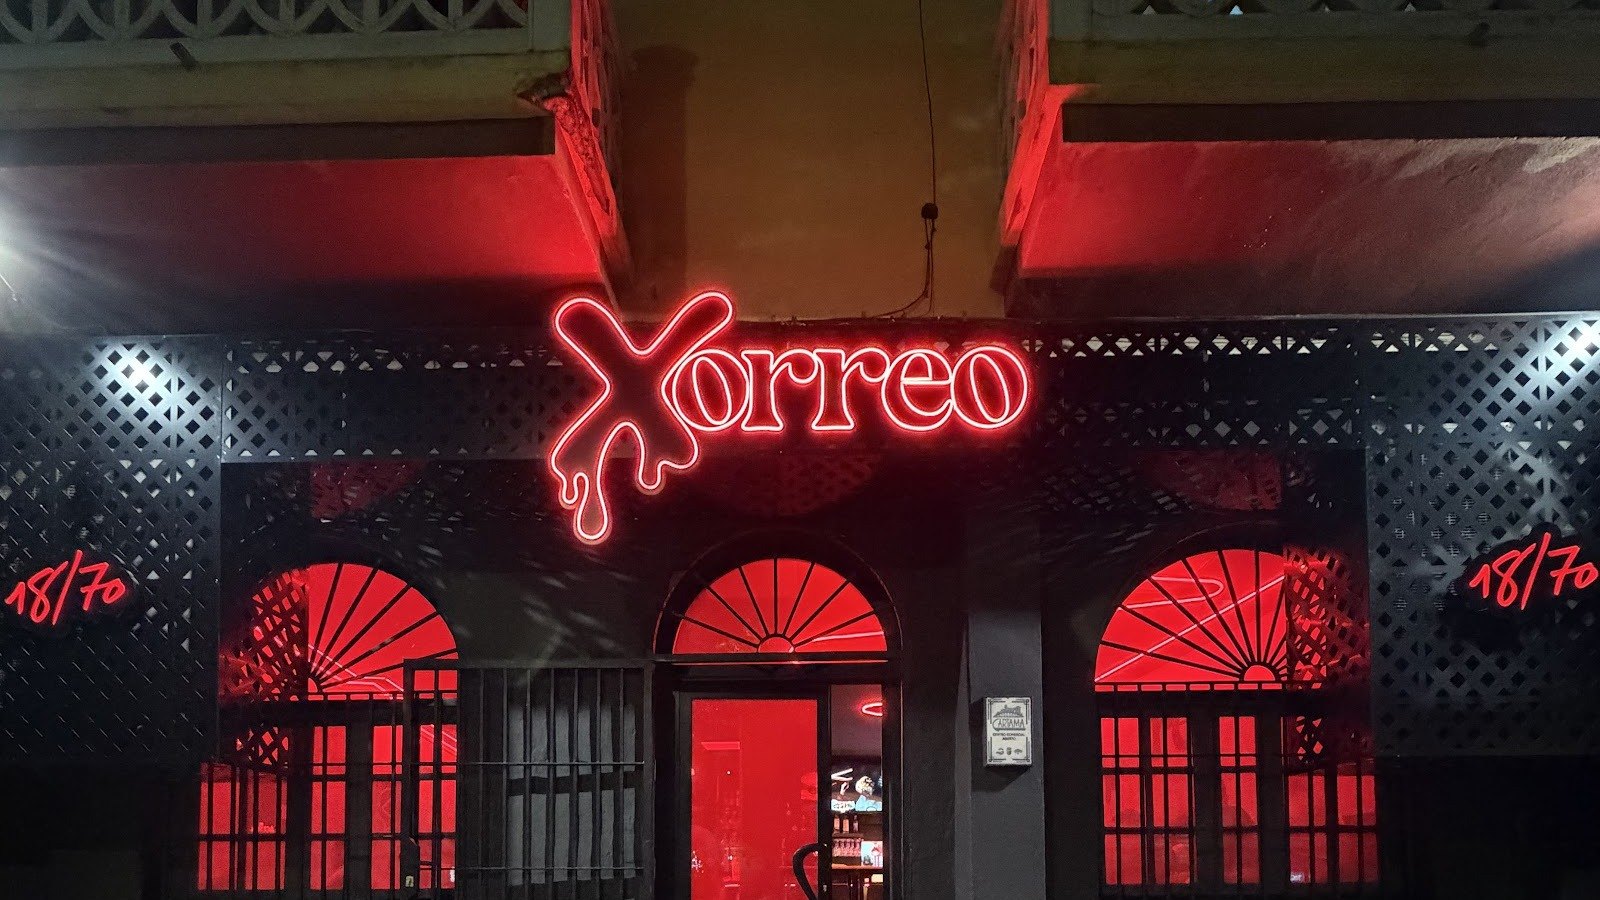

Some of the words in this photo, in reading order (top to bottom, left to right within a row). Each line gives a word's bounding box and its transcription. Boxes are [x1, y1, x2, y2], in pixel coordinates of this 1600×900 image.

[550, 291, 1029, 542] Xorreo
[4, 549, 126, 625] 18/70
[1469, 532, 1599, 611] 18/70
